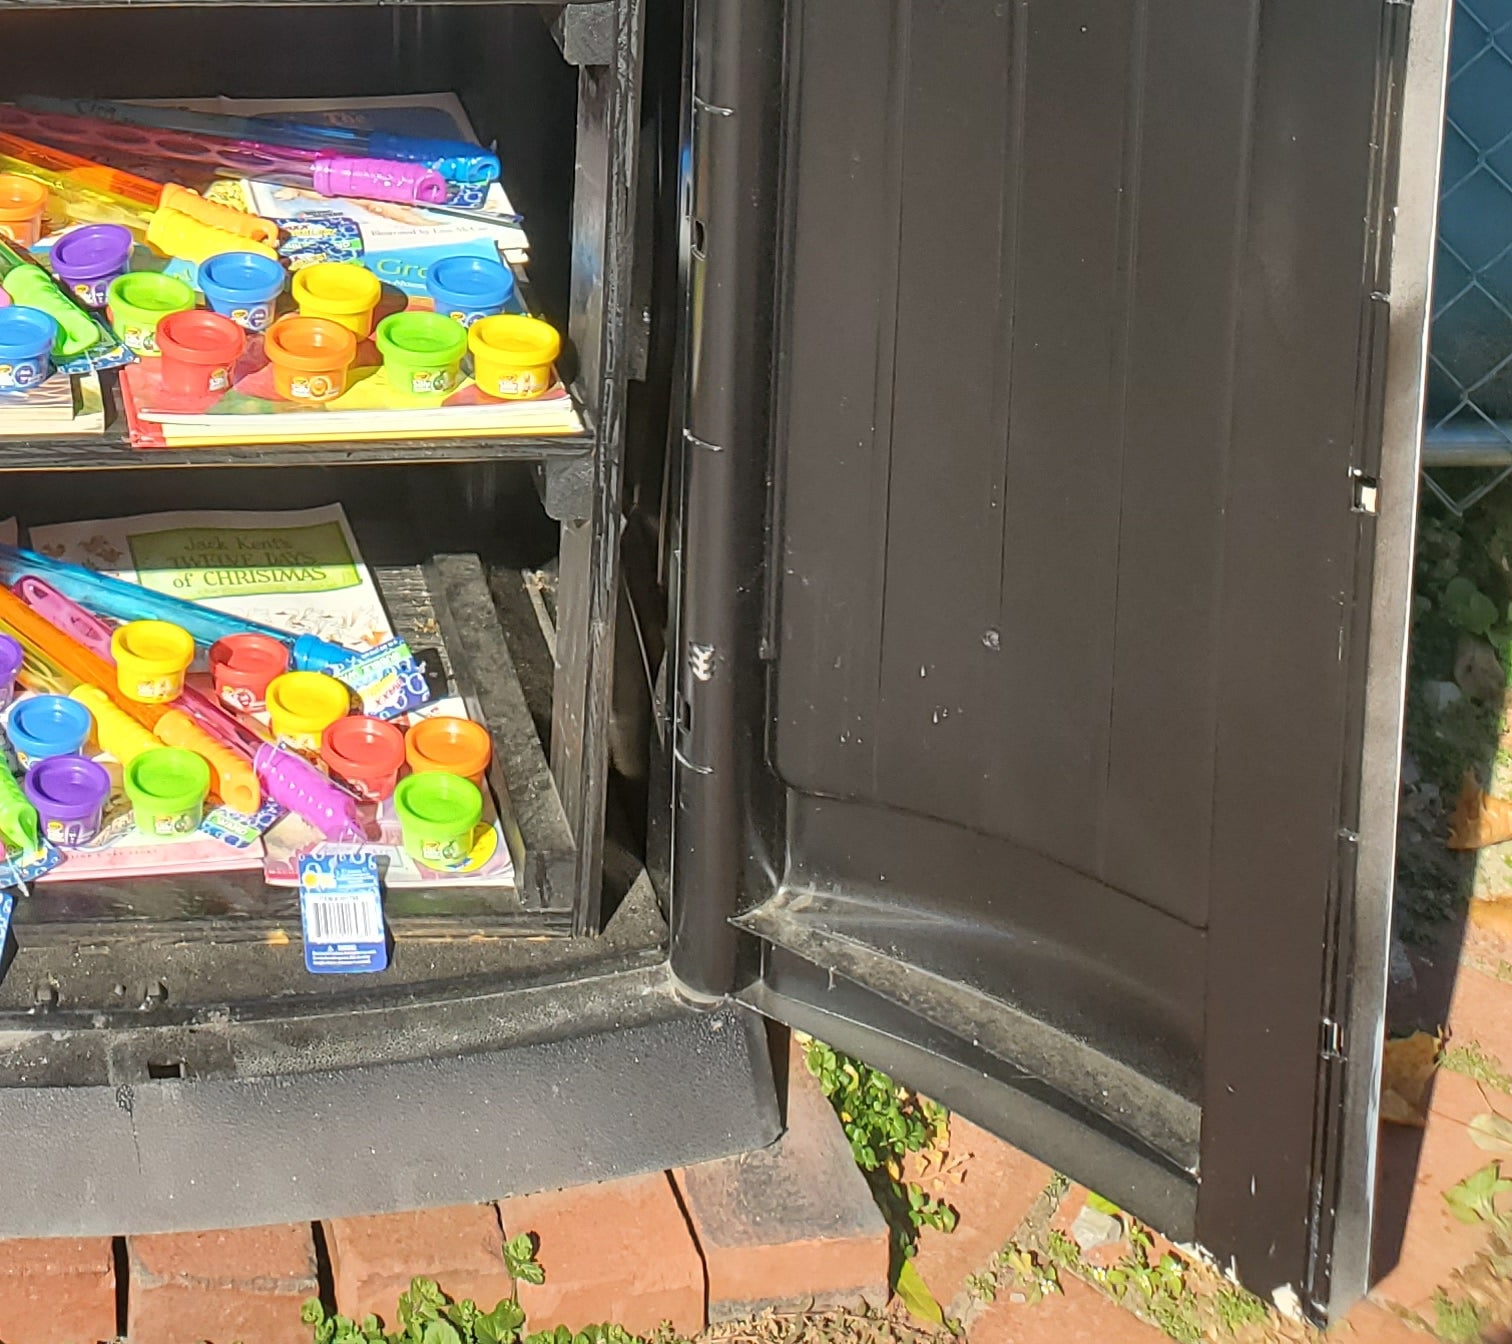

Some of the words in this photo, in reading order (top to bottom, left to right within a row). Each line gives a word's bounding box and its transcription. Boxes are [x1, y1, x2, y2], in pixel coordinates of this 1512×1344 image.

[184, 535, 229, 551] Jack
[164, 552, 257, 569] TWELVE
[265, 550, 318, 566] DAYS
[173, 571, 194, 589] of
[203, 566, 327, 587] CHRISTMAS
